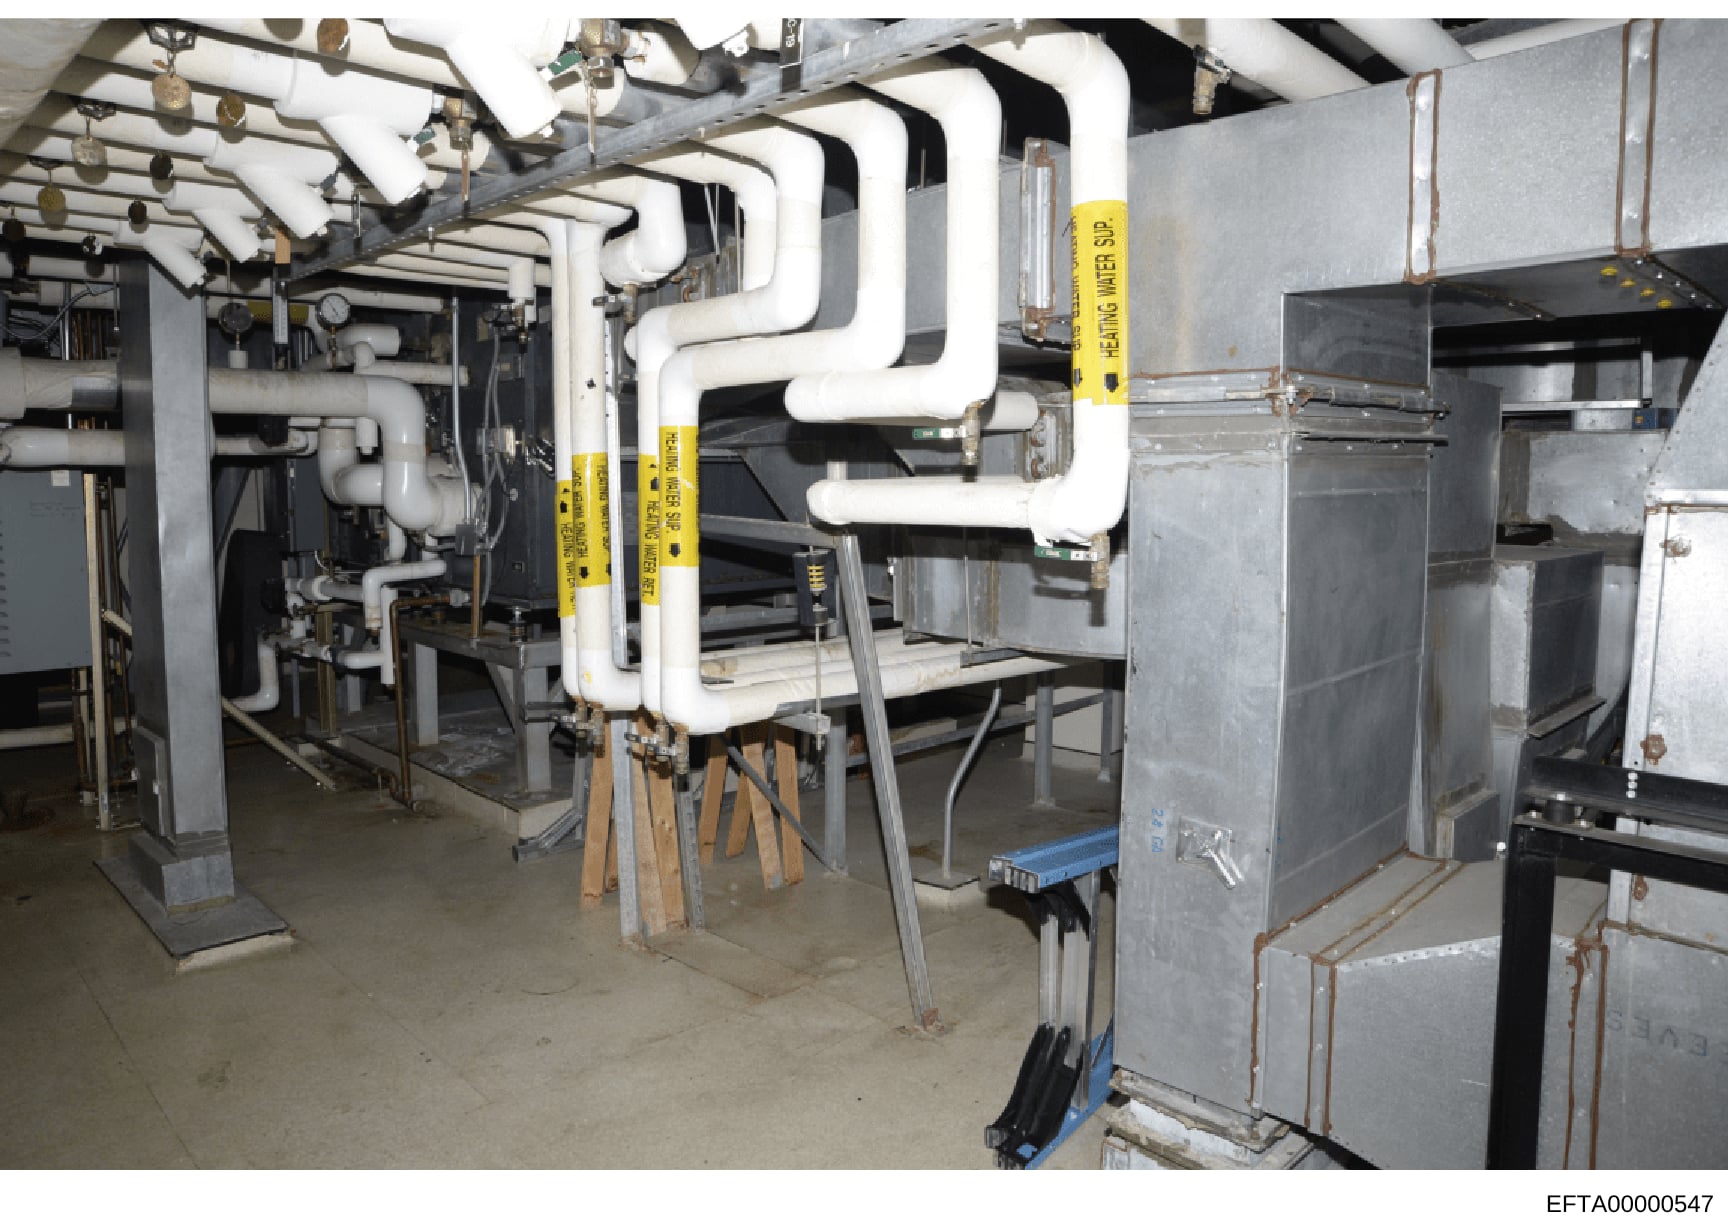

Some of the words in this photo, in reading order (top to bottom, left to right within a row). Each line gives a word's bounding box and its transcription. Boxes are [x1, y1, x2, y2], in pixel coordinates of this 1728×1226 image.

[1093, 217, 1116, 247] SUP.
[1094, 253, 1117, 298] WATER
[1097, 302, 1120, 358] HEATING
[666, 431, 681, 472] HEATING
[665, 478, 681, 508] WATER
[645, 500, 660, 540] HEATING
[560, 522, 574, 558] HEATING
[575, 521, 589, 559] HEATING
[643, 543, 658, 576] WATER
[641, 577, 655, 598] RET.
[1607, 1009, 1728, 1065] EVES
